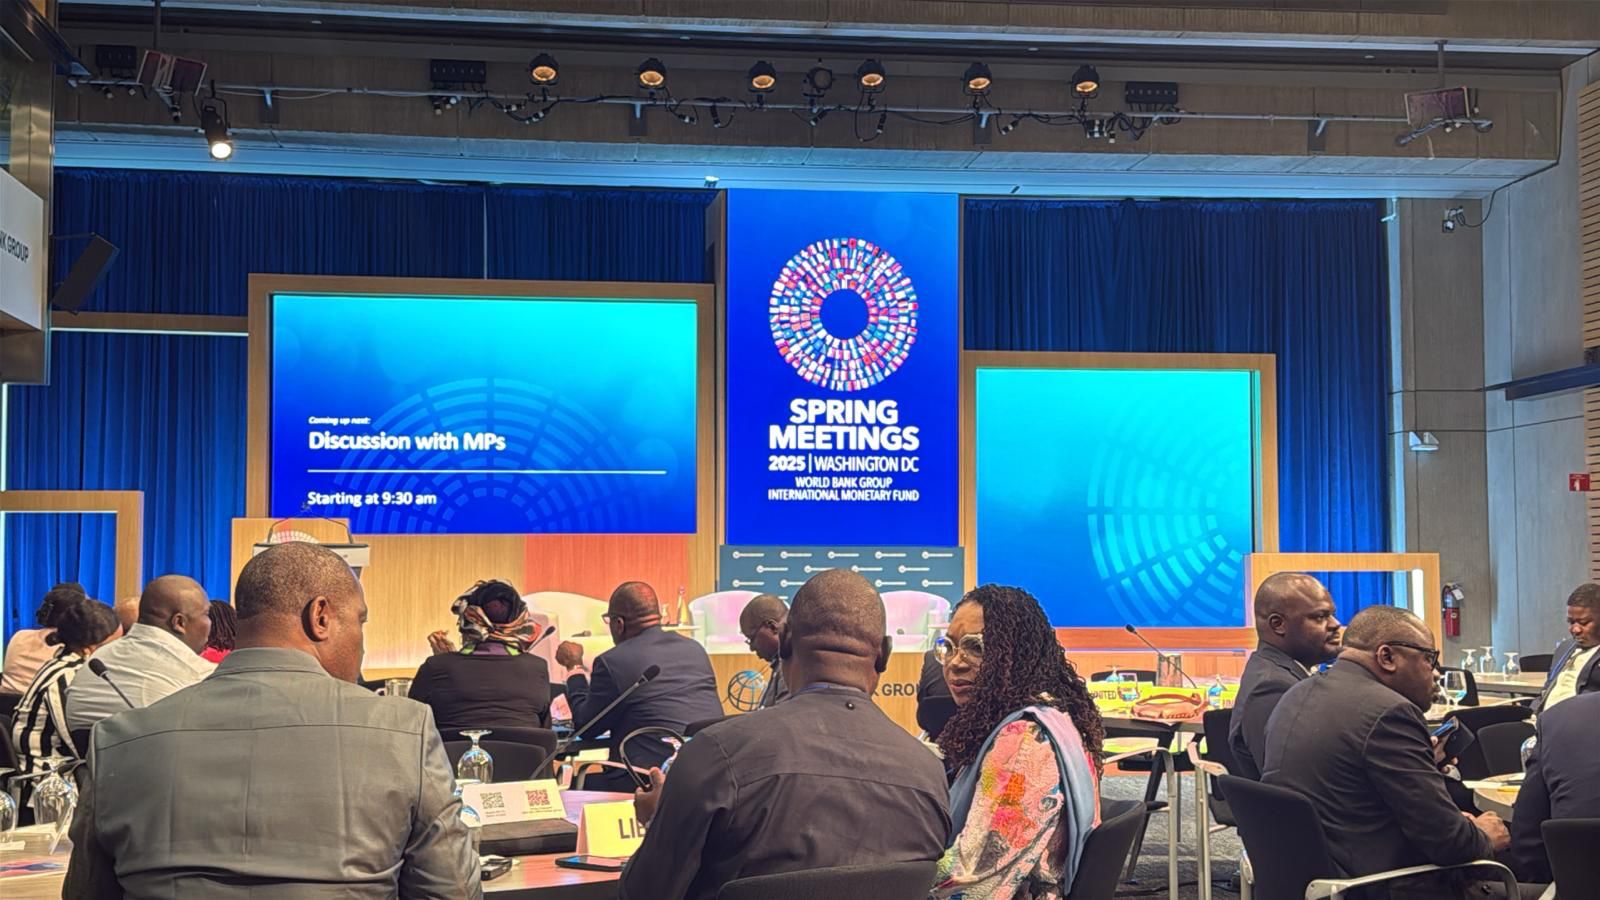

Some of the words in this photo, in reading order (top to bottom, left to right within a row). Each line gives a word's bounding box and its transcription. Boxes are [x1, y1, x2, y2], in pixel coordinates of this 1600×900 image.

[7, 235, 29, 263] GROUP
[789, 398, 898, 424] SPRING
[308, 416, 338, 426] Coming
[340, 417, 350, 426] up
[351, 416, 371, 425] next:
[309, 431, 411, 450] Discussion
[415, 432, 459, 450] with
[463, 432, 506, 451] MPs
[769, 424, 920, 451] MEETINGS
[768, 455, 806, 471] 2025
[814, 456, 898, 472] WASHINGTON
[901, 456, 919, 472] DC
[795, 476, 830, 488] WORLD
[832, 476, 857, 488] BANK
[859, 477, 893, 488] GROUP
[308, 491, 362, 507] Starting
[365, 494, 379, 505] at
[382, 492, 413, 505] 9:30
[415, 495, 437, 505] am
[768, 489, 839, 501] INTERNATIONAL
[841, 490, 891, 501] MONETARY
[893, 490, 919, 502] FUND
[881, 683, 920, 697] GRO
